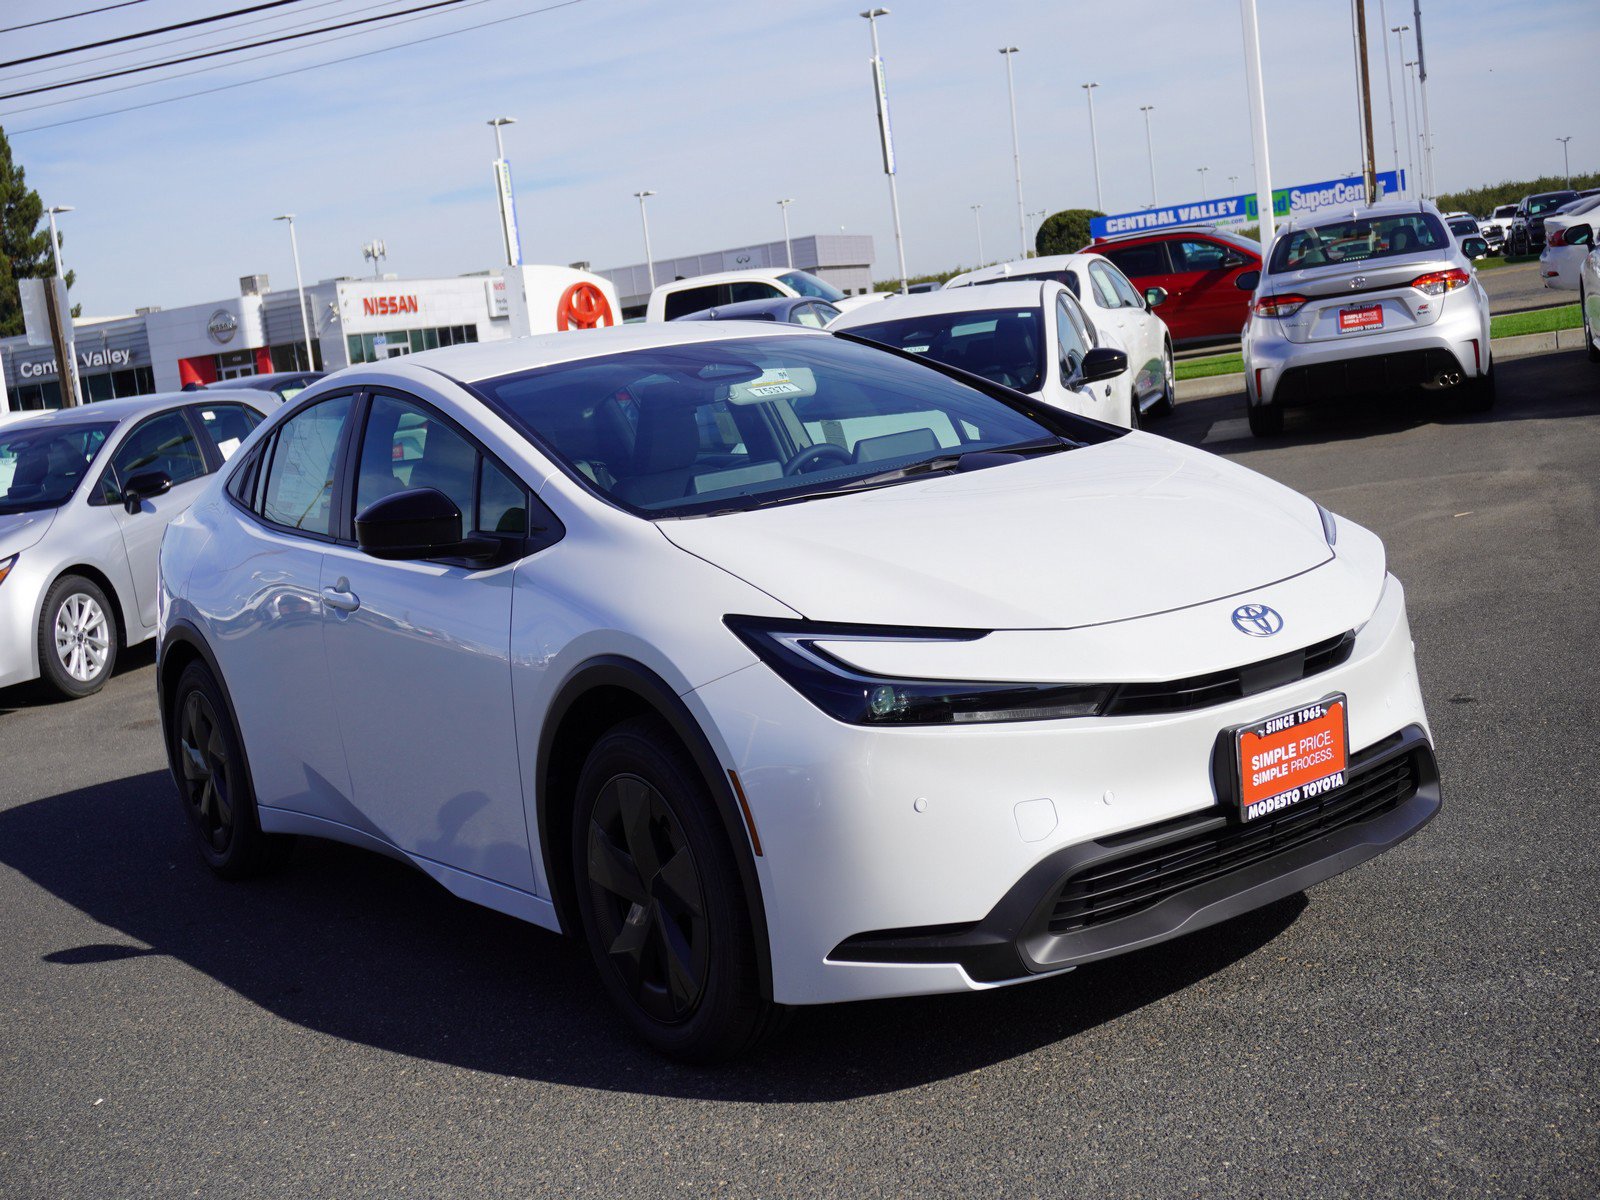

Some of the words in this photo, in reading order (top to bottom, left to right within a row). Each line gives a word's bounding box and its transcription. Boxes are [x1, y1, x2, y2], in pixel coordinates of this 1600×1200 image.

[1106, 211, 1176, 232] CENTRAL
[1178, 200, 1238, 221] VALLEY
[1290, 180, 1387, 212] SuperCenr
[363, 294, 418, 316] NISSAN
[81, 348, 131, 367] Valley
[1265, 714, 1295, 734] SINCE
[1297, 705, 1322, 723] 1965
[1251, 742, 1298, 771] SIMPLE
[1299, 729, 1334, 755] PRICE.
[1252, 763, 1289, 787] SIMPLE
[1290, 747, 1335, 773] PROCESS.
[1248, 788, 1301, 820] MODESTO
[1302, 772, 1344, 800] TOYOTA
